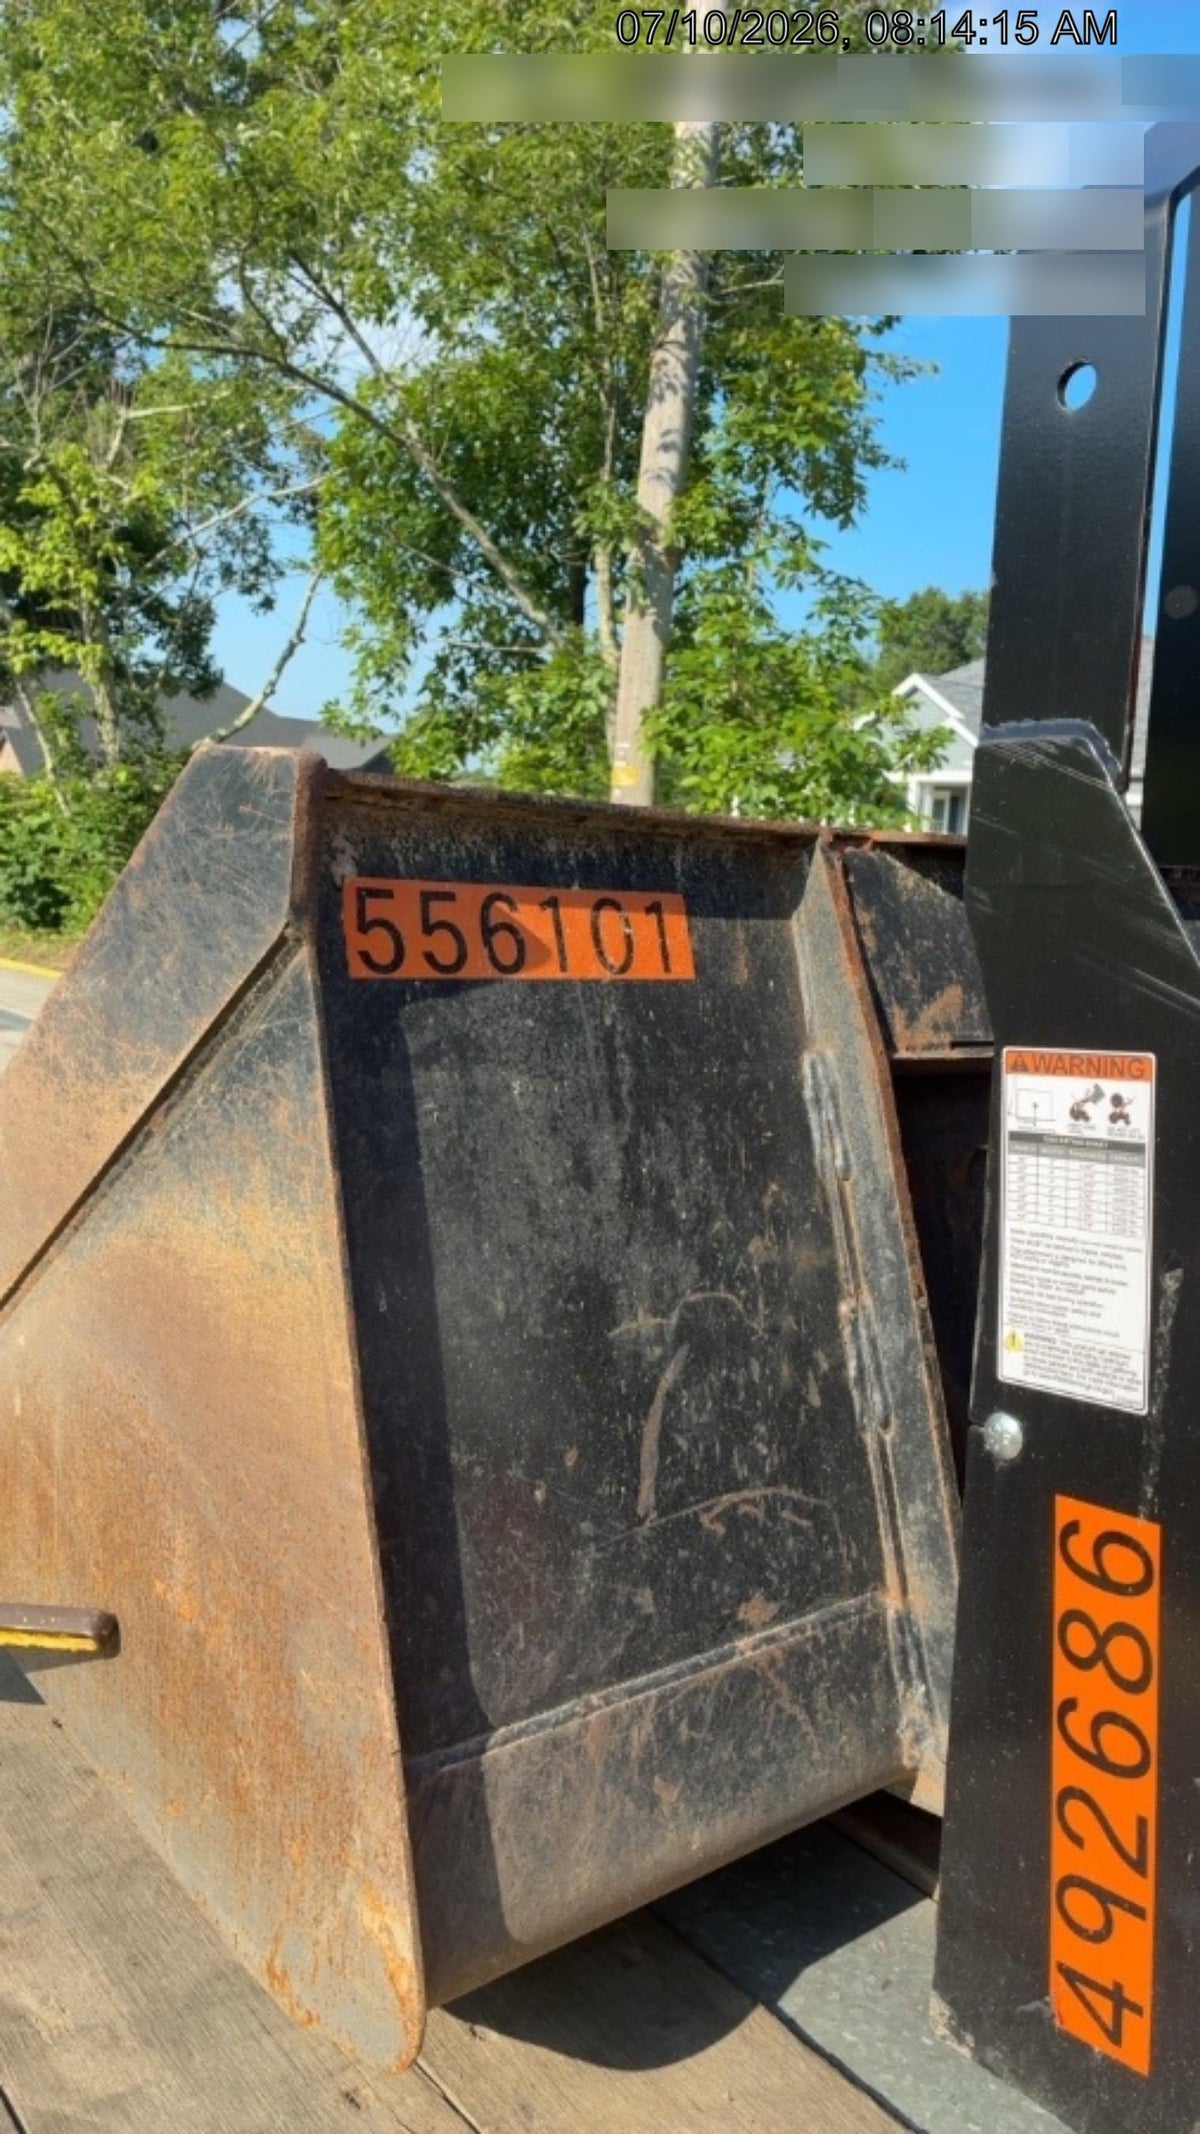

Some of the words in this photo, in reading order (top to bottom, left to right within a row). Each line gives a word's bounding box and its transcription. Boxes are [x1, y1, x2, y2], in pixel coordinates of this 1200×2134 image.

[356, 886, 671, 975] 556101
[1031, 1054, 1145, 1080] WARNING
[1056, 1519, 1155, 2048] 492686
